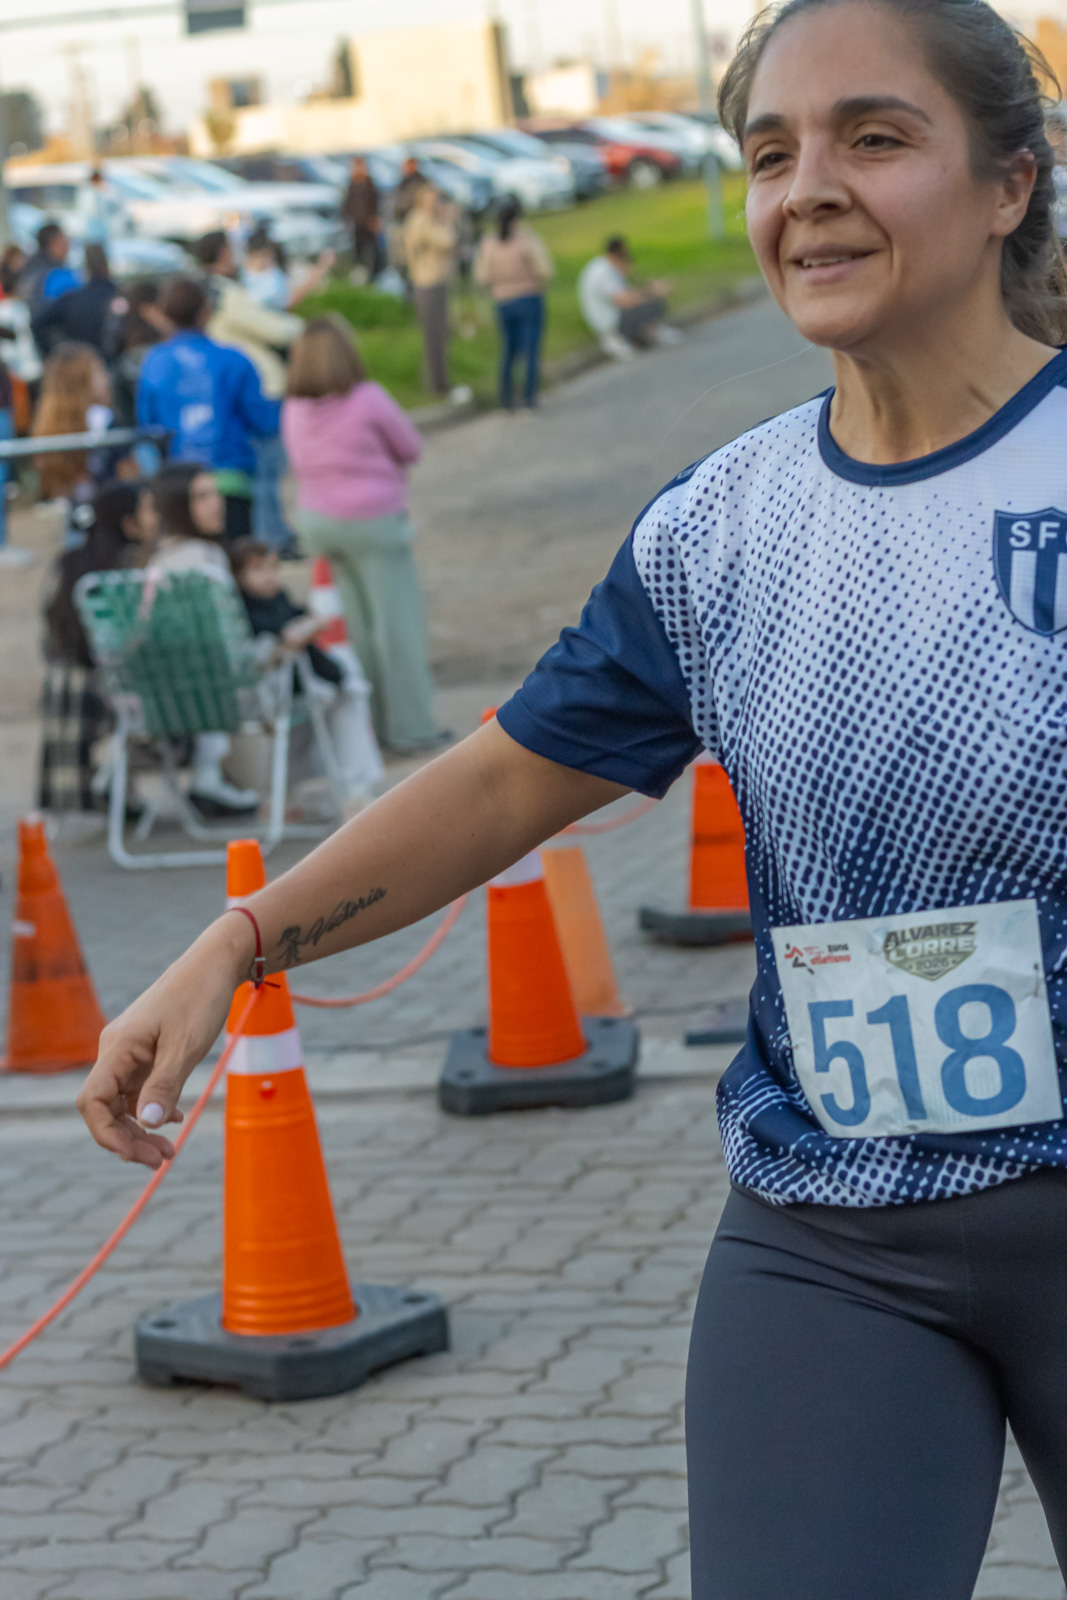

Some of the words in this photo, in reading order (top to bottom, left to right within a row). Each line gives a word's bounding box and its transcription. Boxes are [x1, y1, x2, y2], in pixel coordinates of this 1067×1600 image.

[1009, 520, 1067, 549] SF
[304, 887, 387, 946] Victoria
[884, 922, 975, 945] ALVAREZ
[889, 936, 974, 962] CORRE
[807, 983, 1027, 1127] 518
